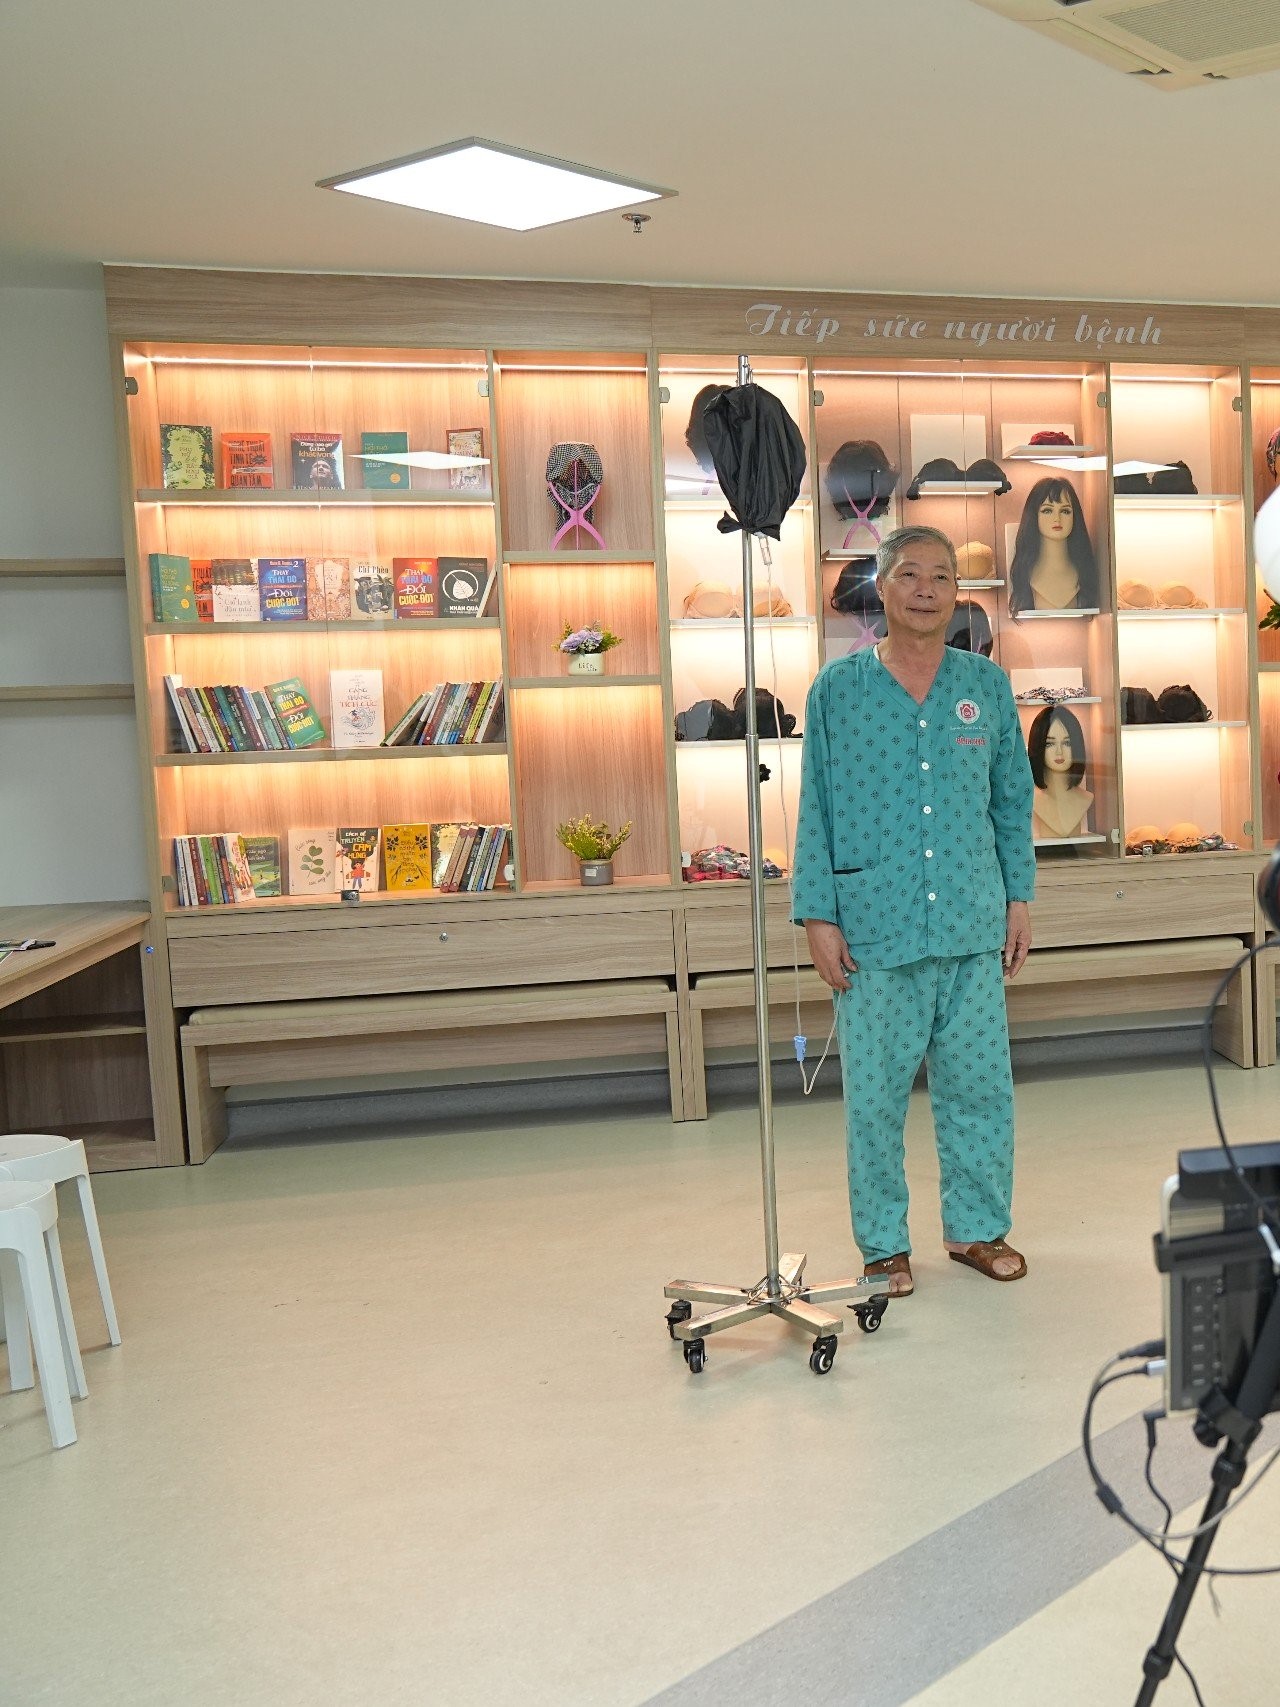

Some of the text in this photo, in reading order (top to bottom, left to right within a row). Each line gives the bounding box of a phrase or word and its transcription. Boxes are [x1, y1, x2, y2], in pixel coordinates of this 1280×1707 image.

[745, 303, 1164, 350] Tiếp sức người bệnh
